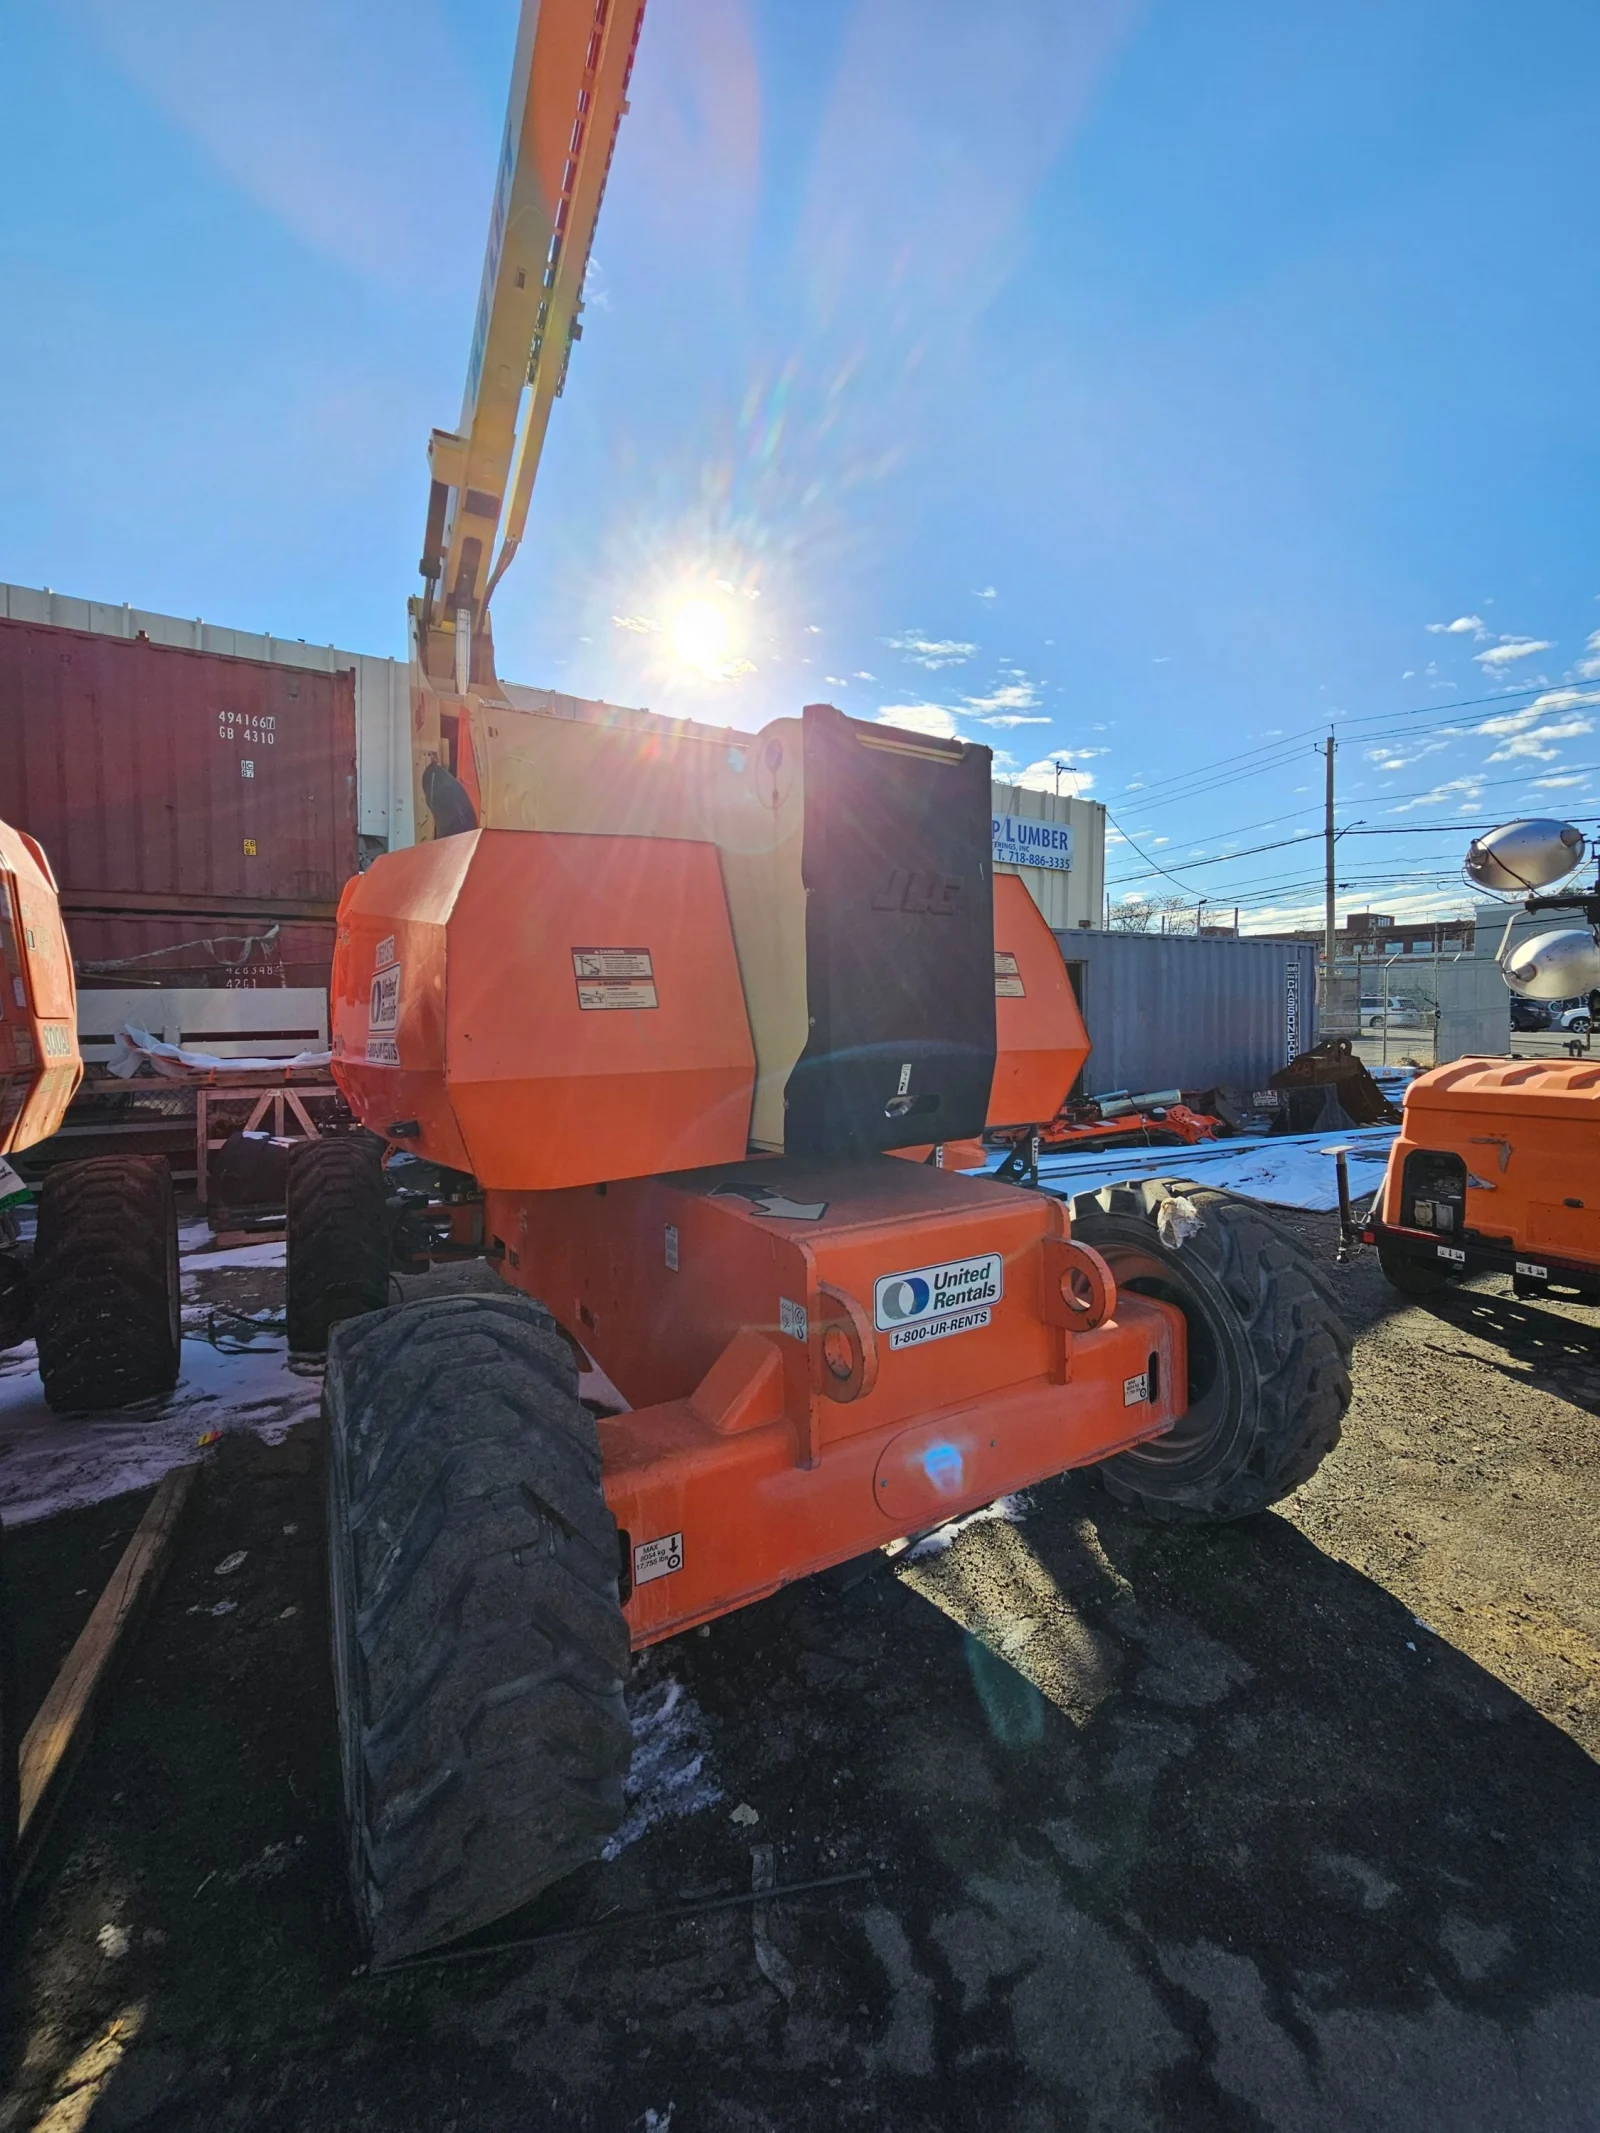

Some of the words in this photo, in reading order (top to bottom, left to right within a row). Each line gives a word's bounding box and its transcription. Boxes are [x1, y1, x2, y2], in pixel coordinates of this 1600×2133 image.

[219, 711, 275, 729] 4941667
[220, 726, 234, 739] GB
[244, 730, 274, 744] 4310
[1006, 818, 1068, 851] LUMBER
[993, 841, 1017, 851] ERINGS,
[1019, 845, 1030, 853] INC
[997, 849, 1005, 861] T.
[1009, 851, 1071, 870] 718-886-3335
[1287, 980, 1295, 1066] CASSONE.CO
[933, 1262, 992, 1291] United
[933, 1282, 996, 1310] Rentals
[893, 1311, 988, 1345] 1-800-UR-RENTS
[643, 1543, 659, 1554] MAX
